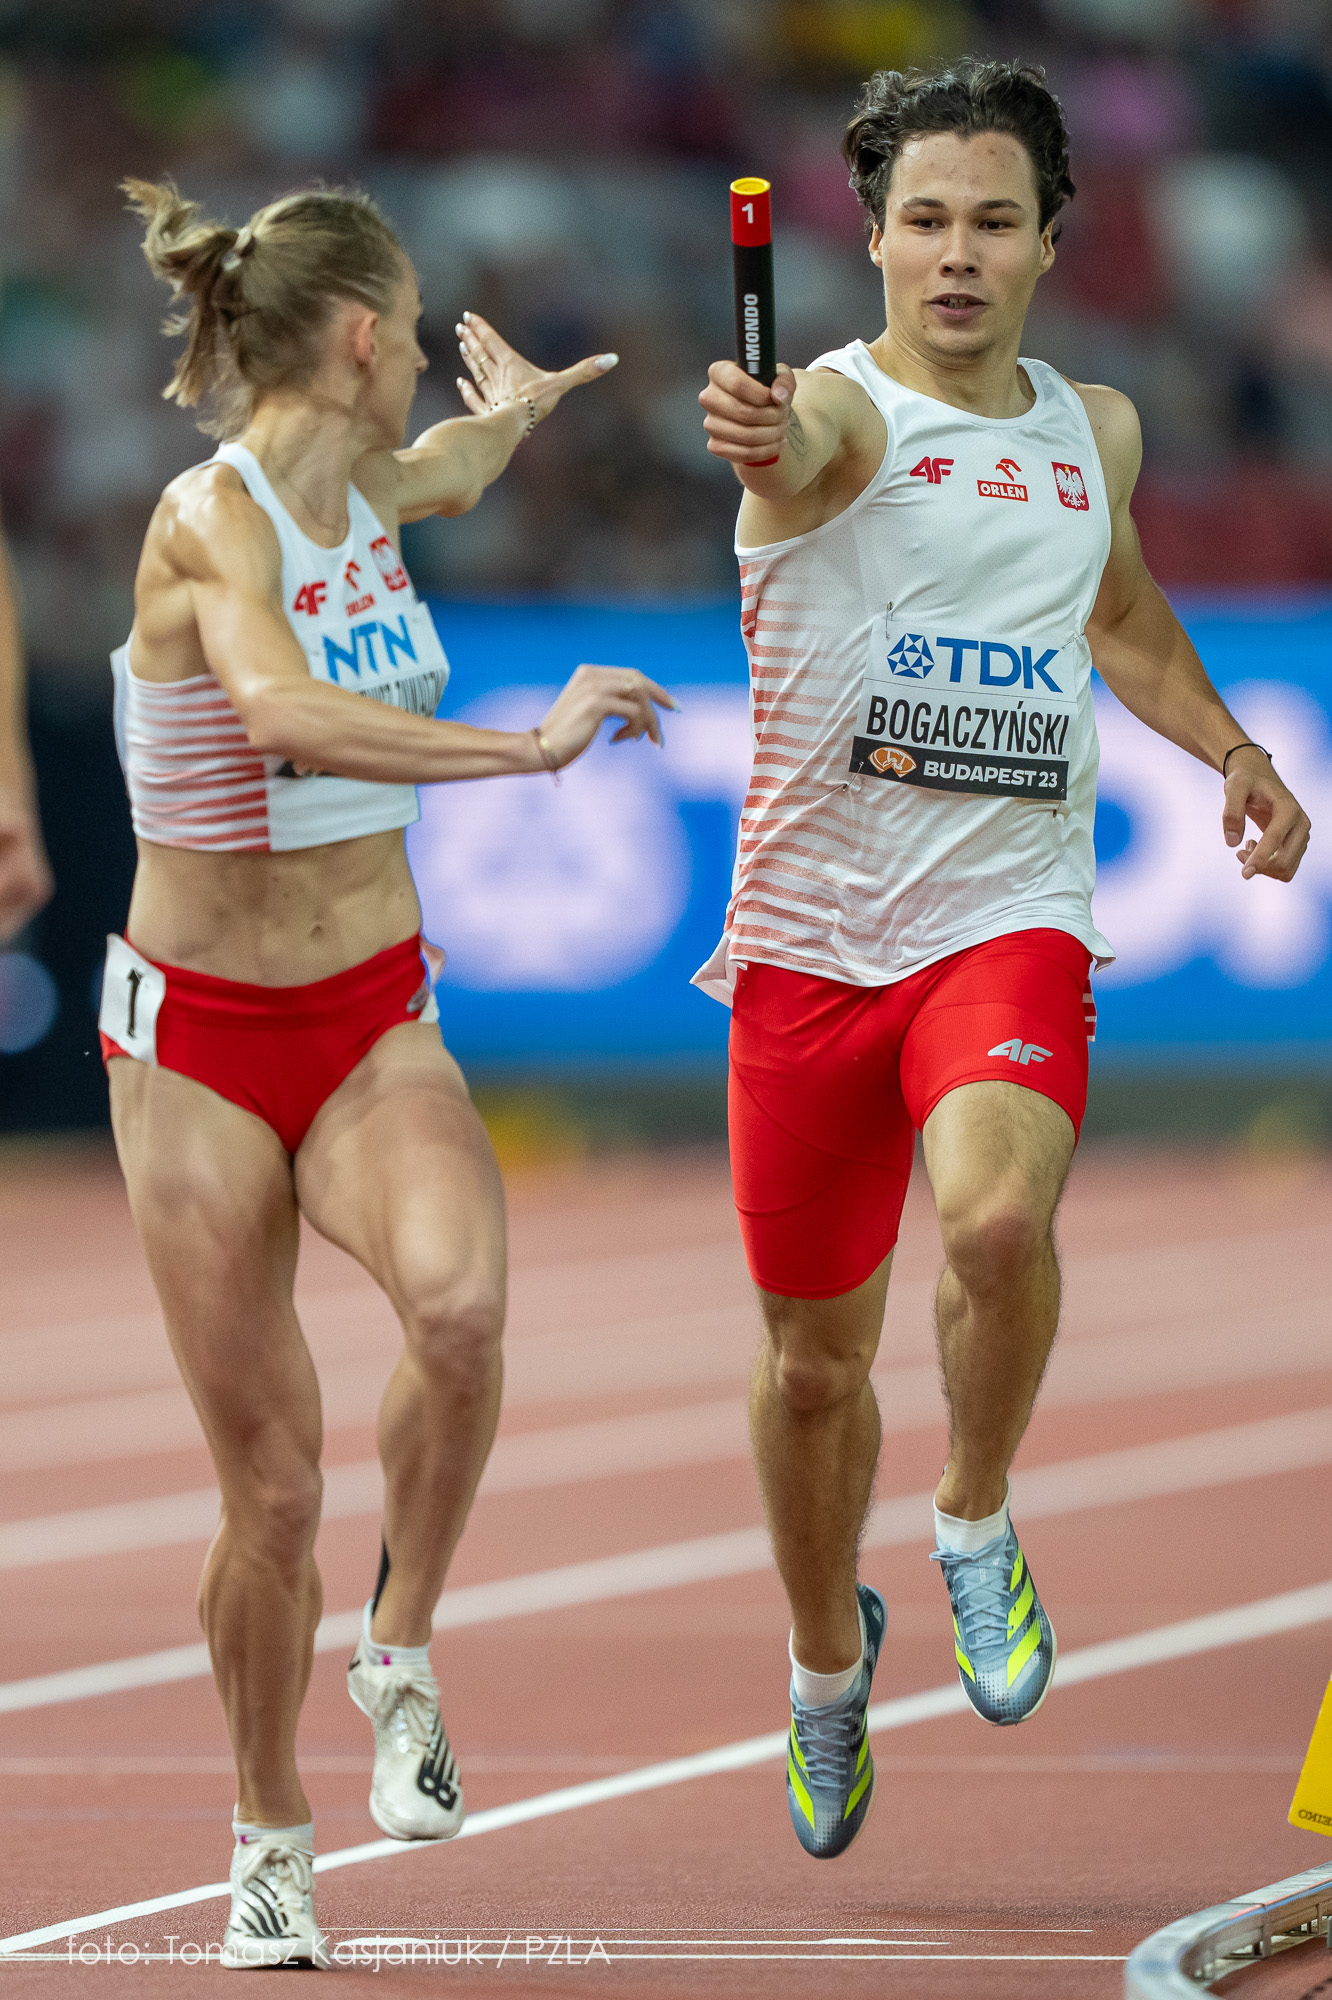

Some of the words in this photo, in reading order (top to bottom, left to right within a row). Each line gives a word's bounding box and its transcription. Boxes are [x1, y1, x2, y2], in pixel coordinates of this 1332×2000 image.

[742, 202, 754, 224] 1
[743, 293, 761, 361] MONDO
[909, 456, 955, 484] 4F
[979, 482, 1026, 499] ORLEN
[293, 580, 328, 617] 4F
[322, 613, 419, 684] NTN
[935, 636, 1064, 694] TDK
[866, 694, 1070, 756] BOGACZYŃSKI
[923, 760, 1037, 787] BUDAPEST
[1038, 771, 1058, 788] 23
[987, 1038, 1054, 1066] 4F
[1298, 1809, 1332, 1827] EIKO
